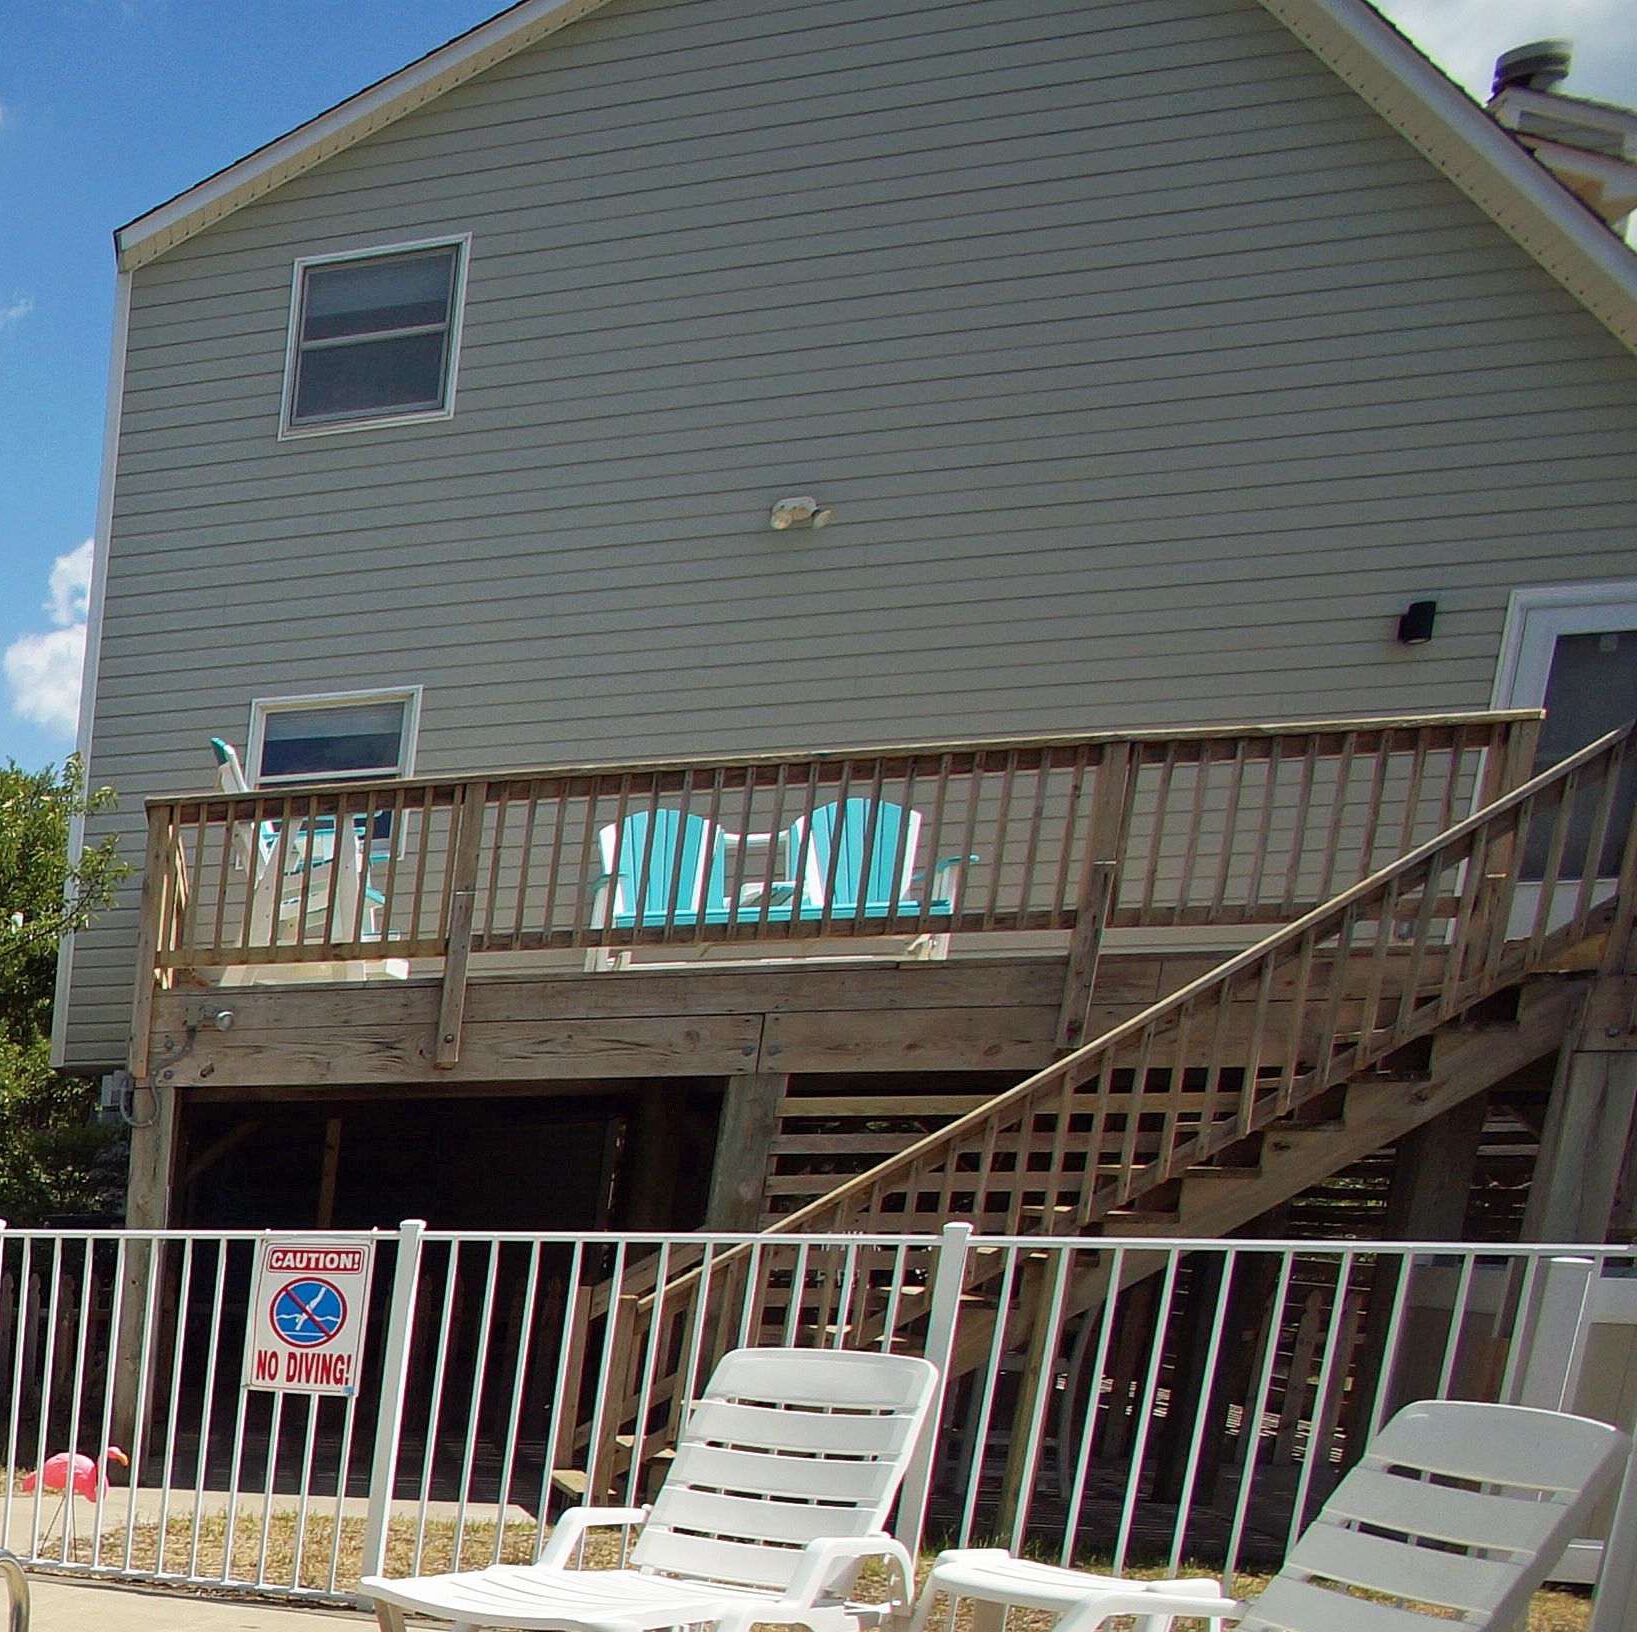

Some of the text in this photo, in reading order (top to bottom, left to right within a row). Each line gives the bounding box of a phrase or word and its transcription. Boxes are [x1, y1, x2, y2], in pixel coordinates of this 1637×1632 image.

[271, 1252, 360, 1269] CAUTION!
[256, 1350, 352, 1385] NO DIVING!
